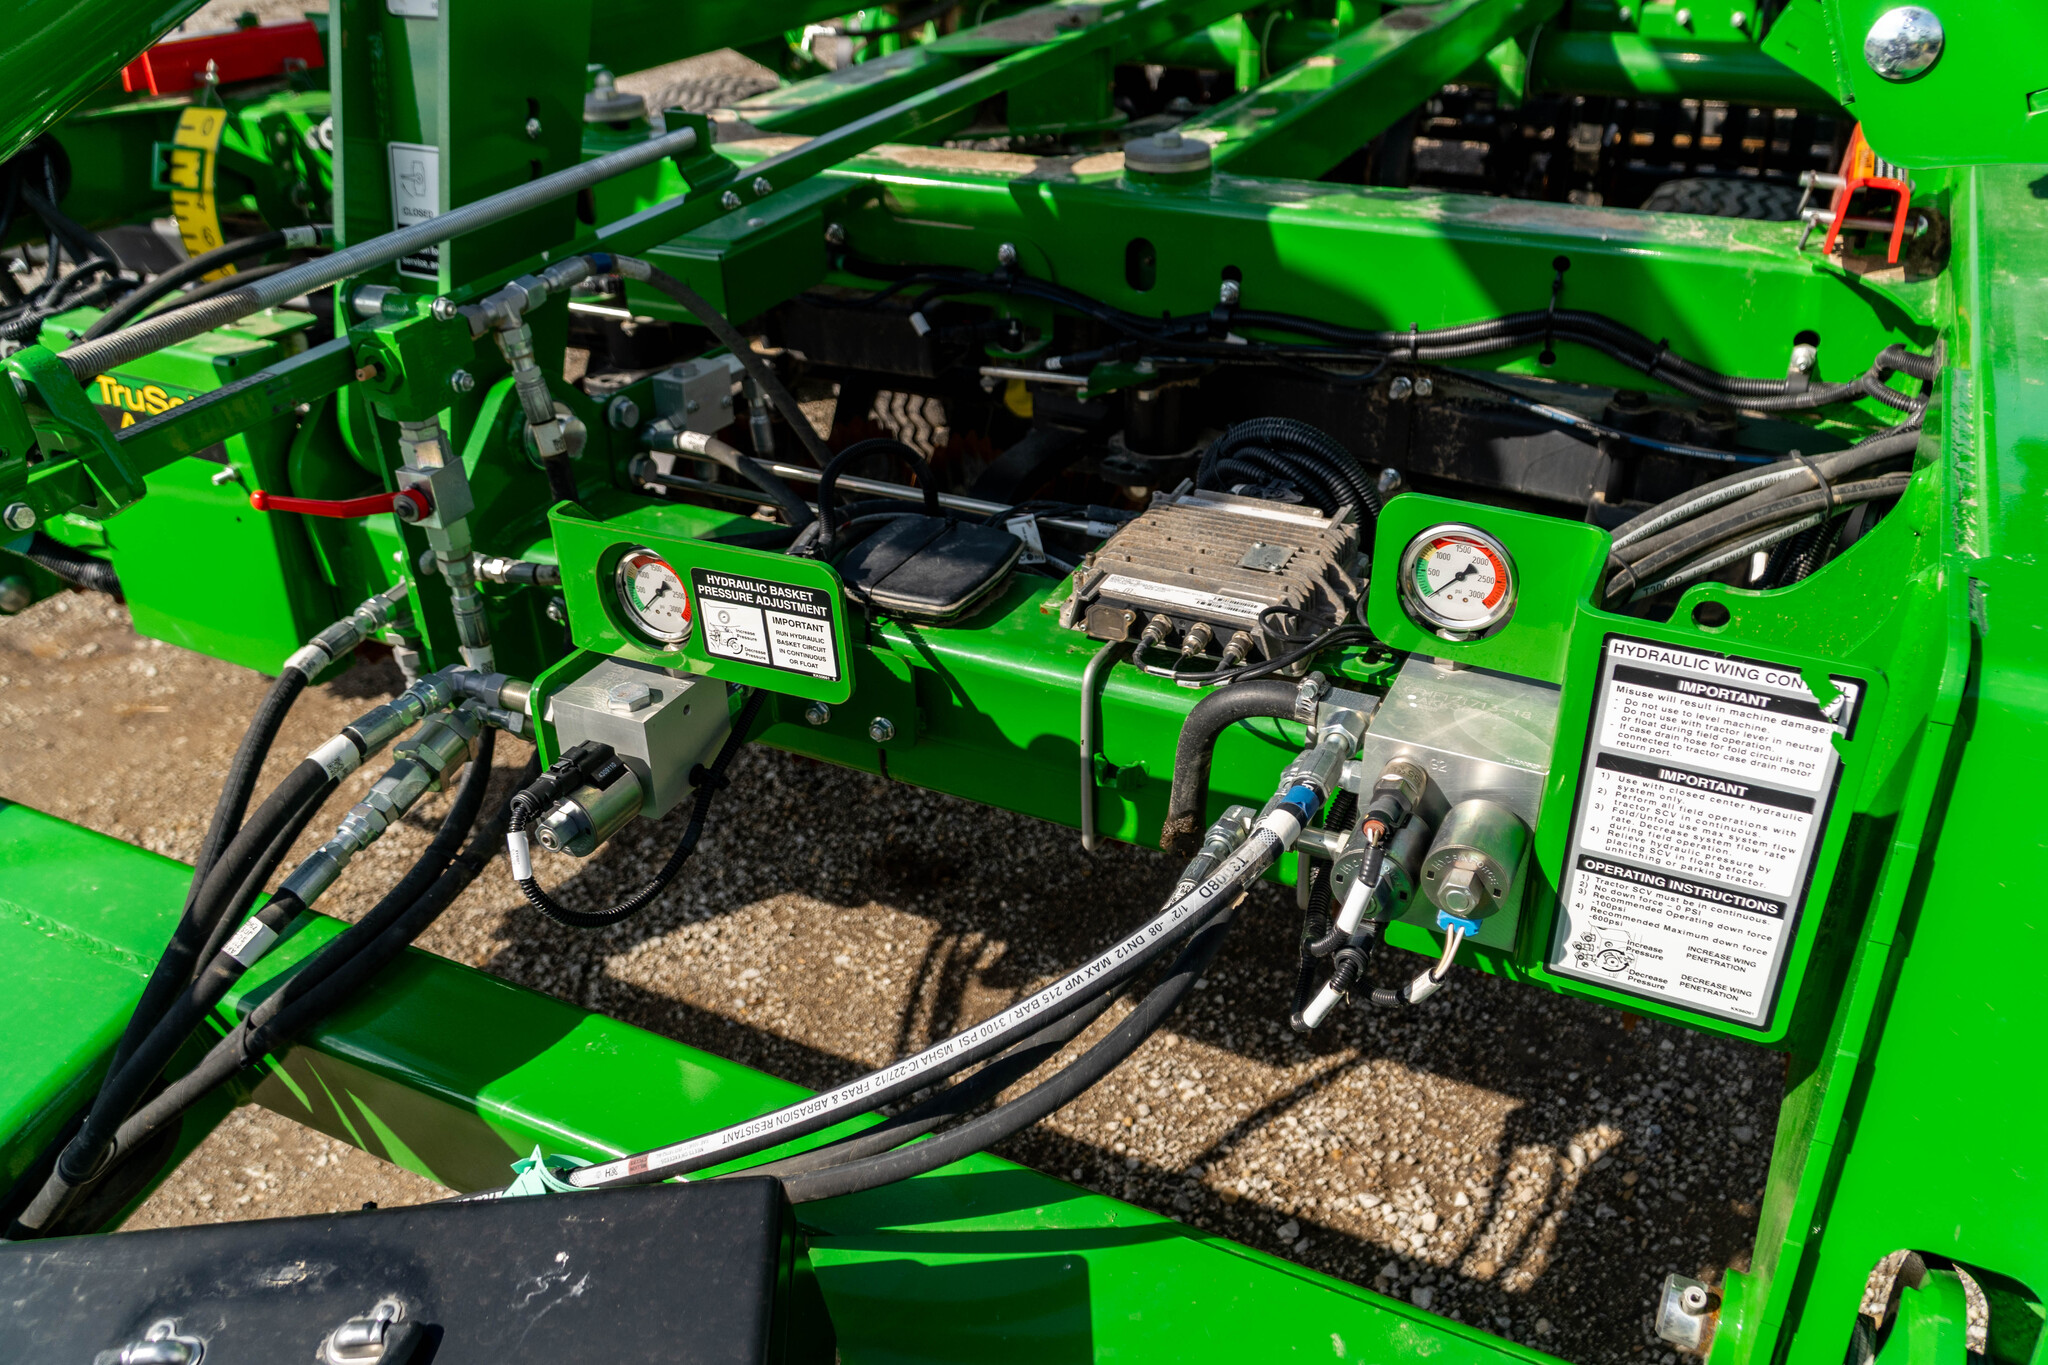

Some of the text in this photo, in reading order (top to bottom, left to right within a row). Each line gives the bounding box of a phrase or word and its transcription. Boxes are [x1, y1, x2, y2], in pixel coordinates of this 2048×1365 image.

[95, 374, 194, 416] TruS
[1436, 551, 1451, 562] 1000
[1456, 544, 1472, 555] 1500
[1472, 556, 1489, 566] 2000
[1427, 568, 1440, 577] 500
[1477, 575, 1495, 585] 2500
[706, 574, 814, 602] HYDRAULIC BASKET
[1469, 590, 1485, 600] 3000
[1642, 575, 1683, 597] T3008D
[697, 584, 828, 616] PRESSURE ADJUSTMENT
[771, 616, 824, 633] IMPORTANT
[776, 638, 826, 653] BASKET CIRCUIT
[789, 632, 824, 643] HYDRAULIC
[786, 649, 826, 662] CONTINUOUS
[799, 660, 818, 669] FLOAT
[1613, 642, 1710, 671] HYDRAULIC
[1714, 661, 1759, 680] WING
[1677, 680, 1771, 707] IMPORTANT
[1616, 684, 1829, 734] Misuse will result machine damage:
[1695, 712, 1769, 733] level machine.
[1634, 717, 1774, 752] float during field operation.
[1705, 723, 1823, 753] tractor lever neutral
[1616, 740, 1672, 756] return port.
[1617, 731, 1811, 777] connected tractor drain motor
[1654, 730, 1783, 763] drain hose circuit
[1659, 768, 1748, 796] IMPORTANT
[1617, 784, 1684, 804] system only.
[1618, 775, 1803, 822] Use closed center hydraulic
[1614, 799, 1760, 838] tractor SCV continuous.
[1615, 790, 1768, 831] Perform field operations
[1611, 806, 1768, 847] Fold/Unfold system
[1639, 820, 1732, 847] Decrease system
[1607, 829, 1754, 869] Relieve hydraulic pressure
[1609, 822, 1731, 856] during field operation.
[1604, 845, 1766, 888] unhitching parking tractor.
[1605, 838, 1754, 877] placing SCV float before
[1584, 859, 1778, 914] OPERATING INSTRUCTIONS
[1591, 900, 1626, 912] -100psi
[1595, 876, 1769, 925] Tractor SCV must continuous.
[1610, 889, 1701, 916] down force PSI
[1588, 913, 1623, 926] -600psi
[1592, 891, 1772, 941] Recommended Operating down force
[1148, 921, 1164, 937] -08
[1590, 905, 1768, 956] Recommended Maximum down force
[1115, 935, 1146, 959] DN12
[1625, 945, 1664, 960] Pressure
[1626, 939, 1663, 954] Increase
[1687, 945, 1756, 967] INCREASE WING
[1084, 956, 1112, 979] MAX
[1685, 952, 1746, 973] PENETRATION
[1065, 975, 1085, 991] WP
[1627, 975, 1665, 990] Pressure
[1628, 968, 1668, 984] Decrease
[1680, 973, 1752, 997] DECREASE WING
[1042, 986, 1063, 1004] 215
[1679, 980, 1739, 1001] PENETRATION
[1014, 999, 1041, 1019] BAR
[980, 1017, 1007, 1037] 3100
[959, 1031, 978, 1048] PSI
[920, 1043, 954, 1065] MSHA
[875, 1060, 919, 1087] IC-227/12
[831, 1094, 839, 1105] &
[841, 1081, 870, 1101] FRAS
[776, 1097, 829, 1124] ABRASION
[722, 1118, 773, 1145] RESISTANT
